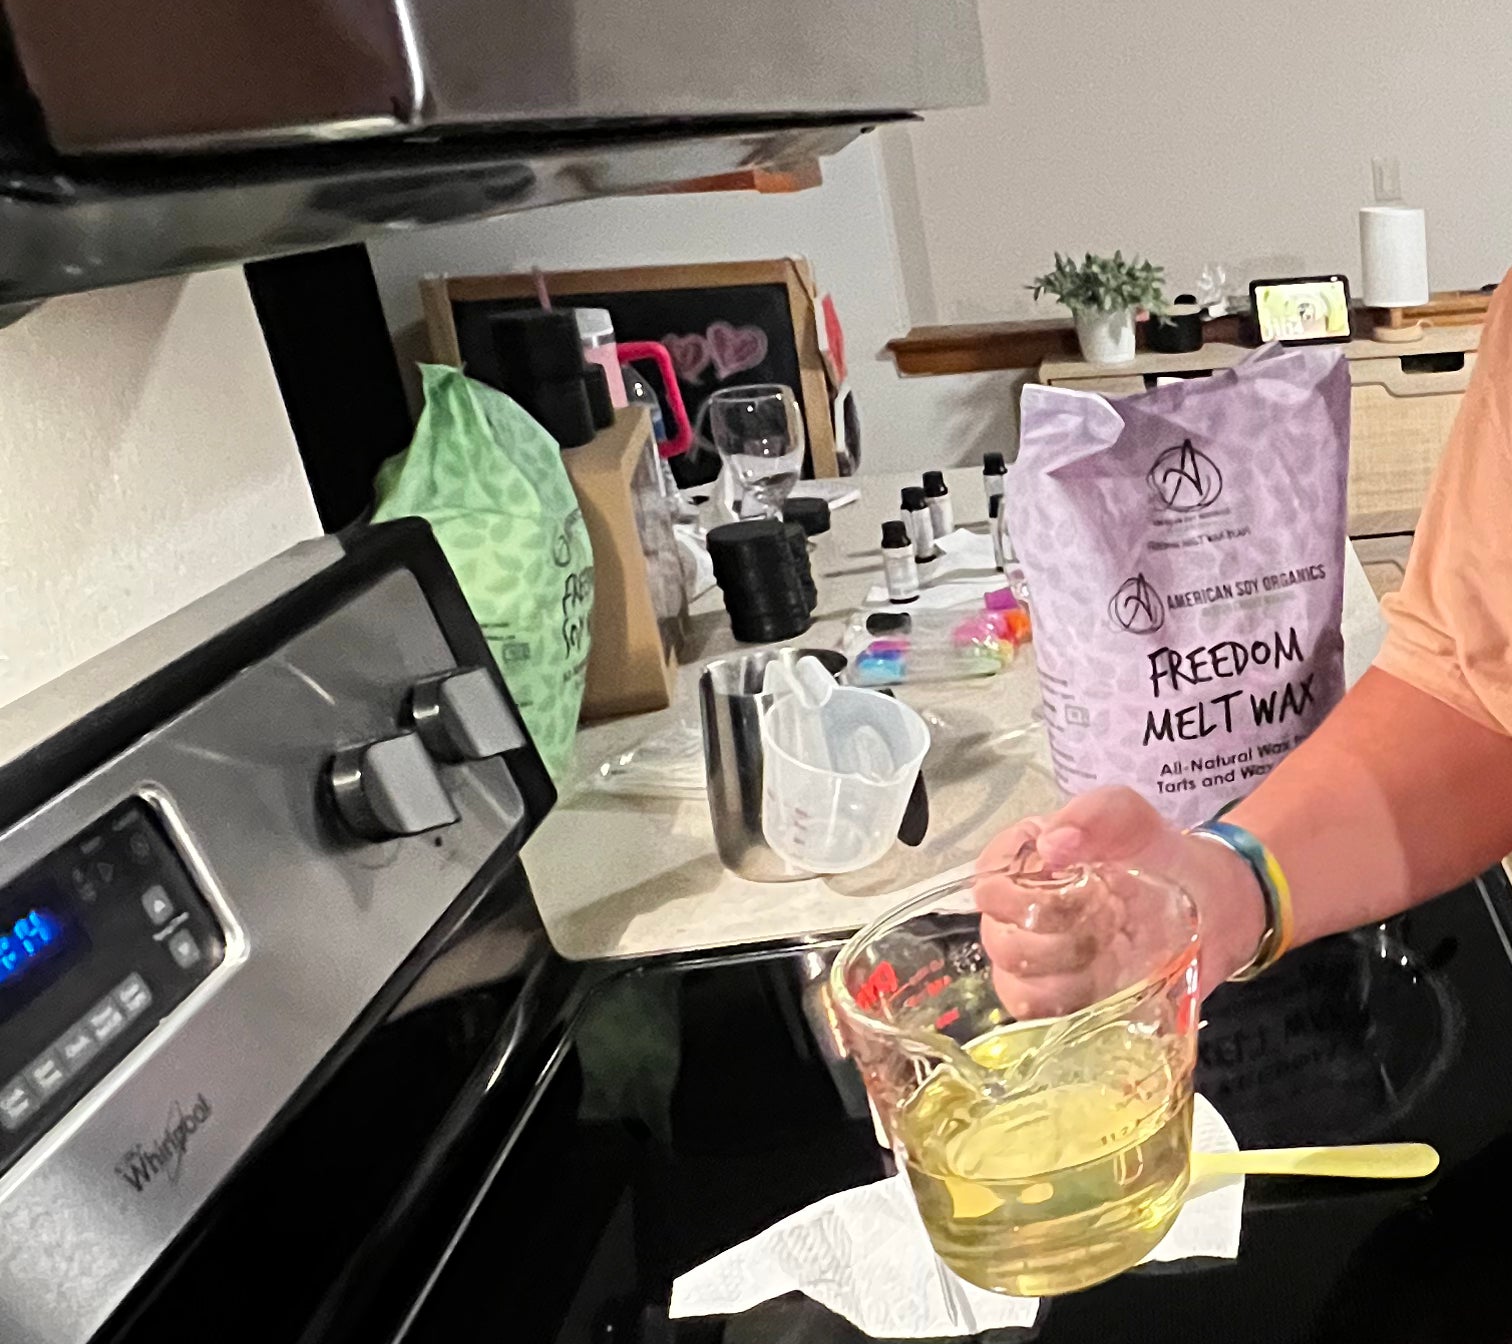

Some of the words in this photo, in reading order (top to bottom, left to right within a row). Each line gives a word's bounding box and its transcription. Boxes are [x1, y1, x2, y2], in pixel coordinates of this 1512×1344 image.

[1166, 584, 1234, 610] AMERICAN
[1235, 579, 1259, 597] SOY
[1262, 564, 1326, 591] ORGANICS
[1147, 626, 1304, 698] FREEDOM
[1142, 689, 1244, 747] MELT
[1250, 672, 1315, 727] WAX
[1157, 777, 1197, 794] Tarts
[1202, 769, 1236, 788] and
[1160, 747, 1253, 777] All-Natural
[121, 1092, 212, 1193] Whirlpool
